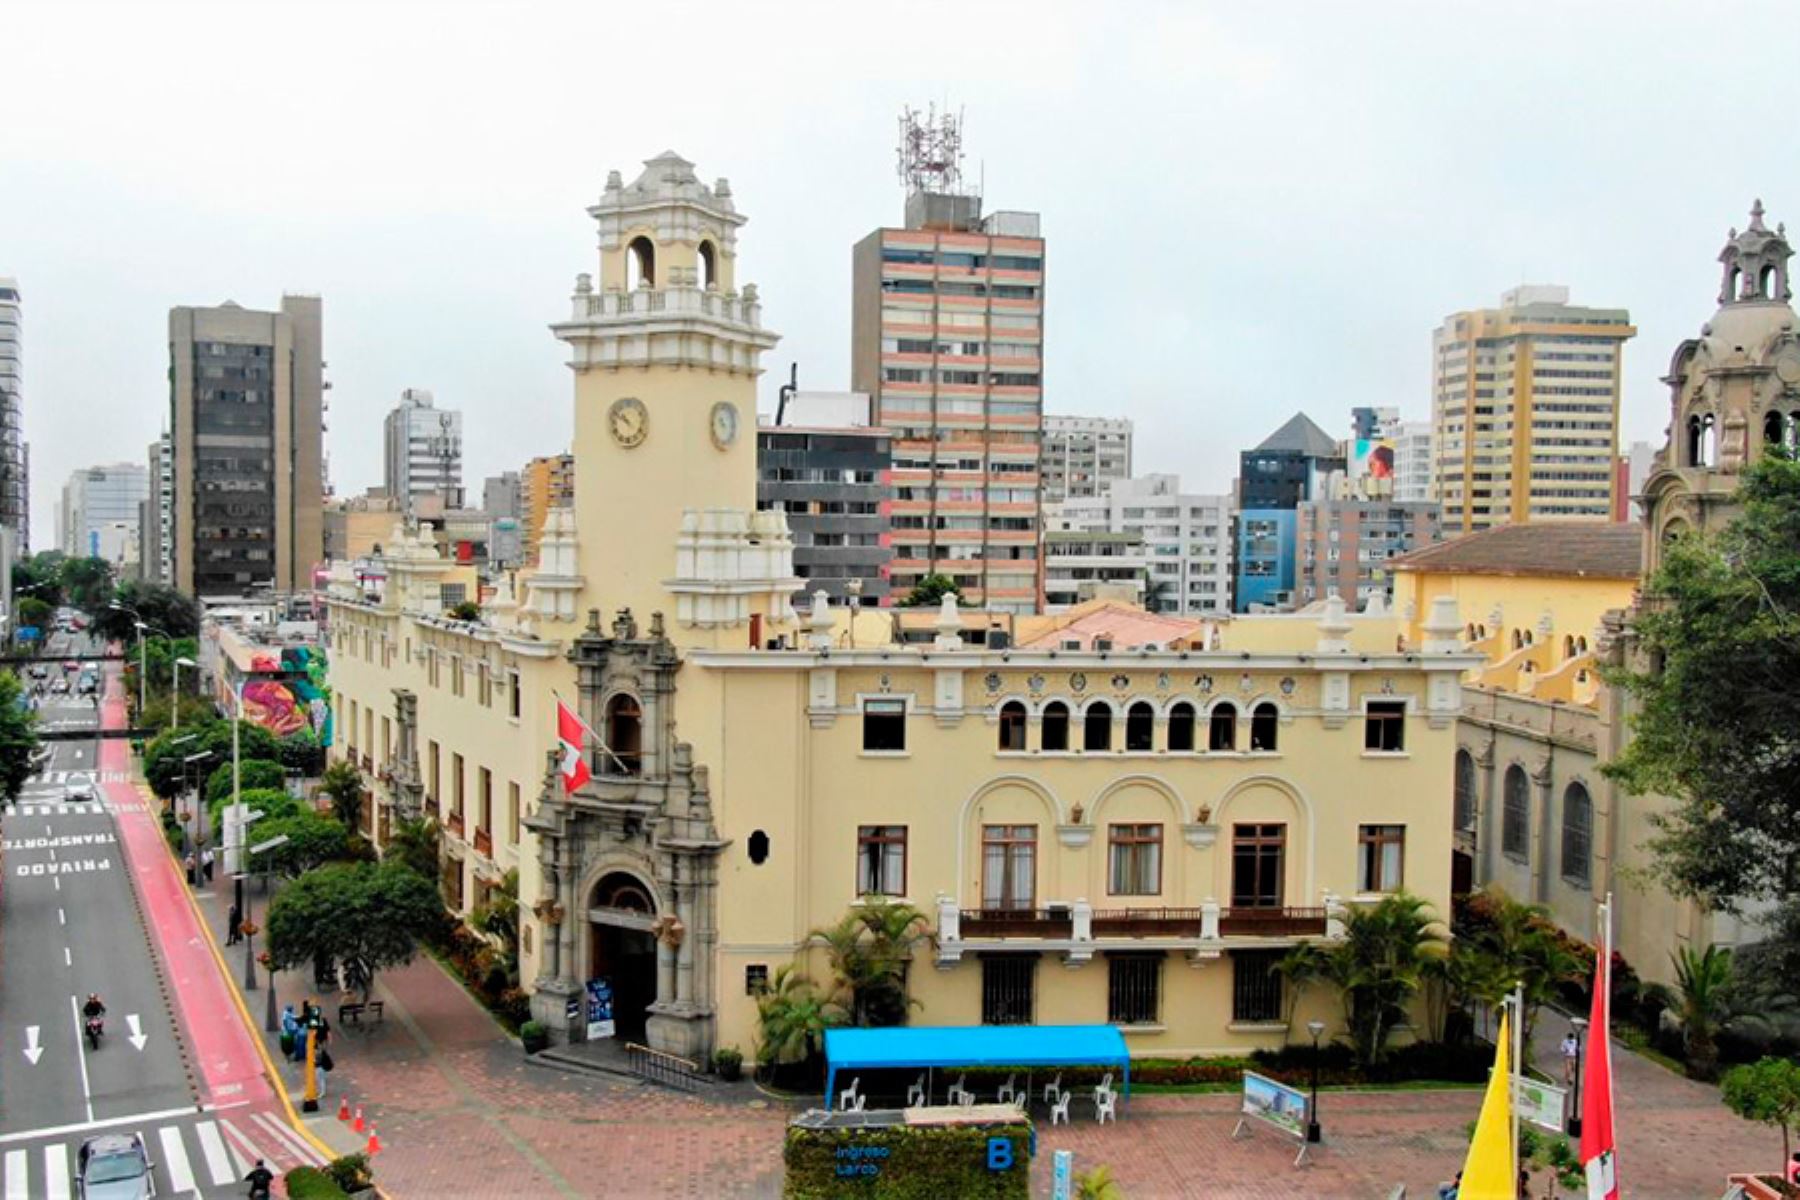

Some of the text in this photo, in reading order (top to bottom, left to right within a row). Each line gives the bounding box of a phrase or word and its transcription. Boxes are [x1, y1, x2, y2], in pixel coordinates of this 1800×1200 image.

[2, 833, 116, 850] TRANSPORTE
[16, 859, 110, 876] PRIVADO
[987, 1137, 1013, 1169] B
